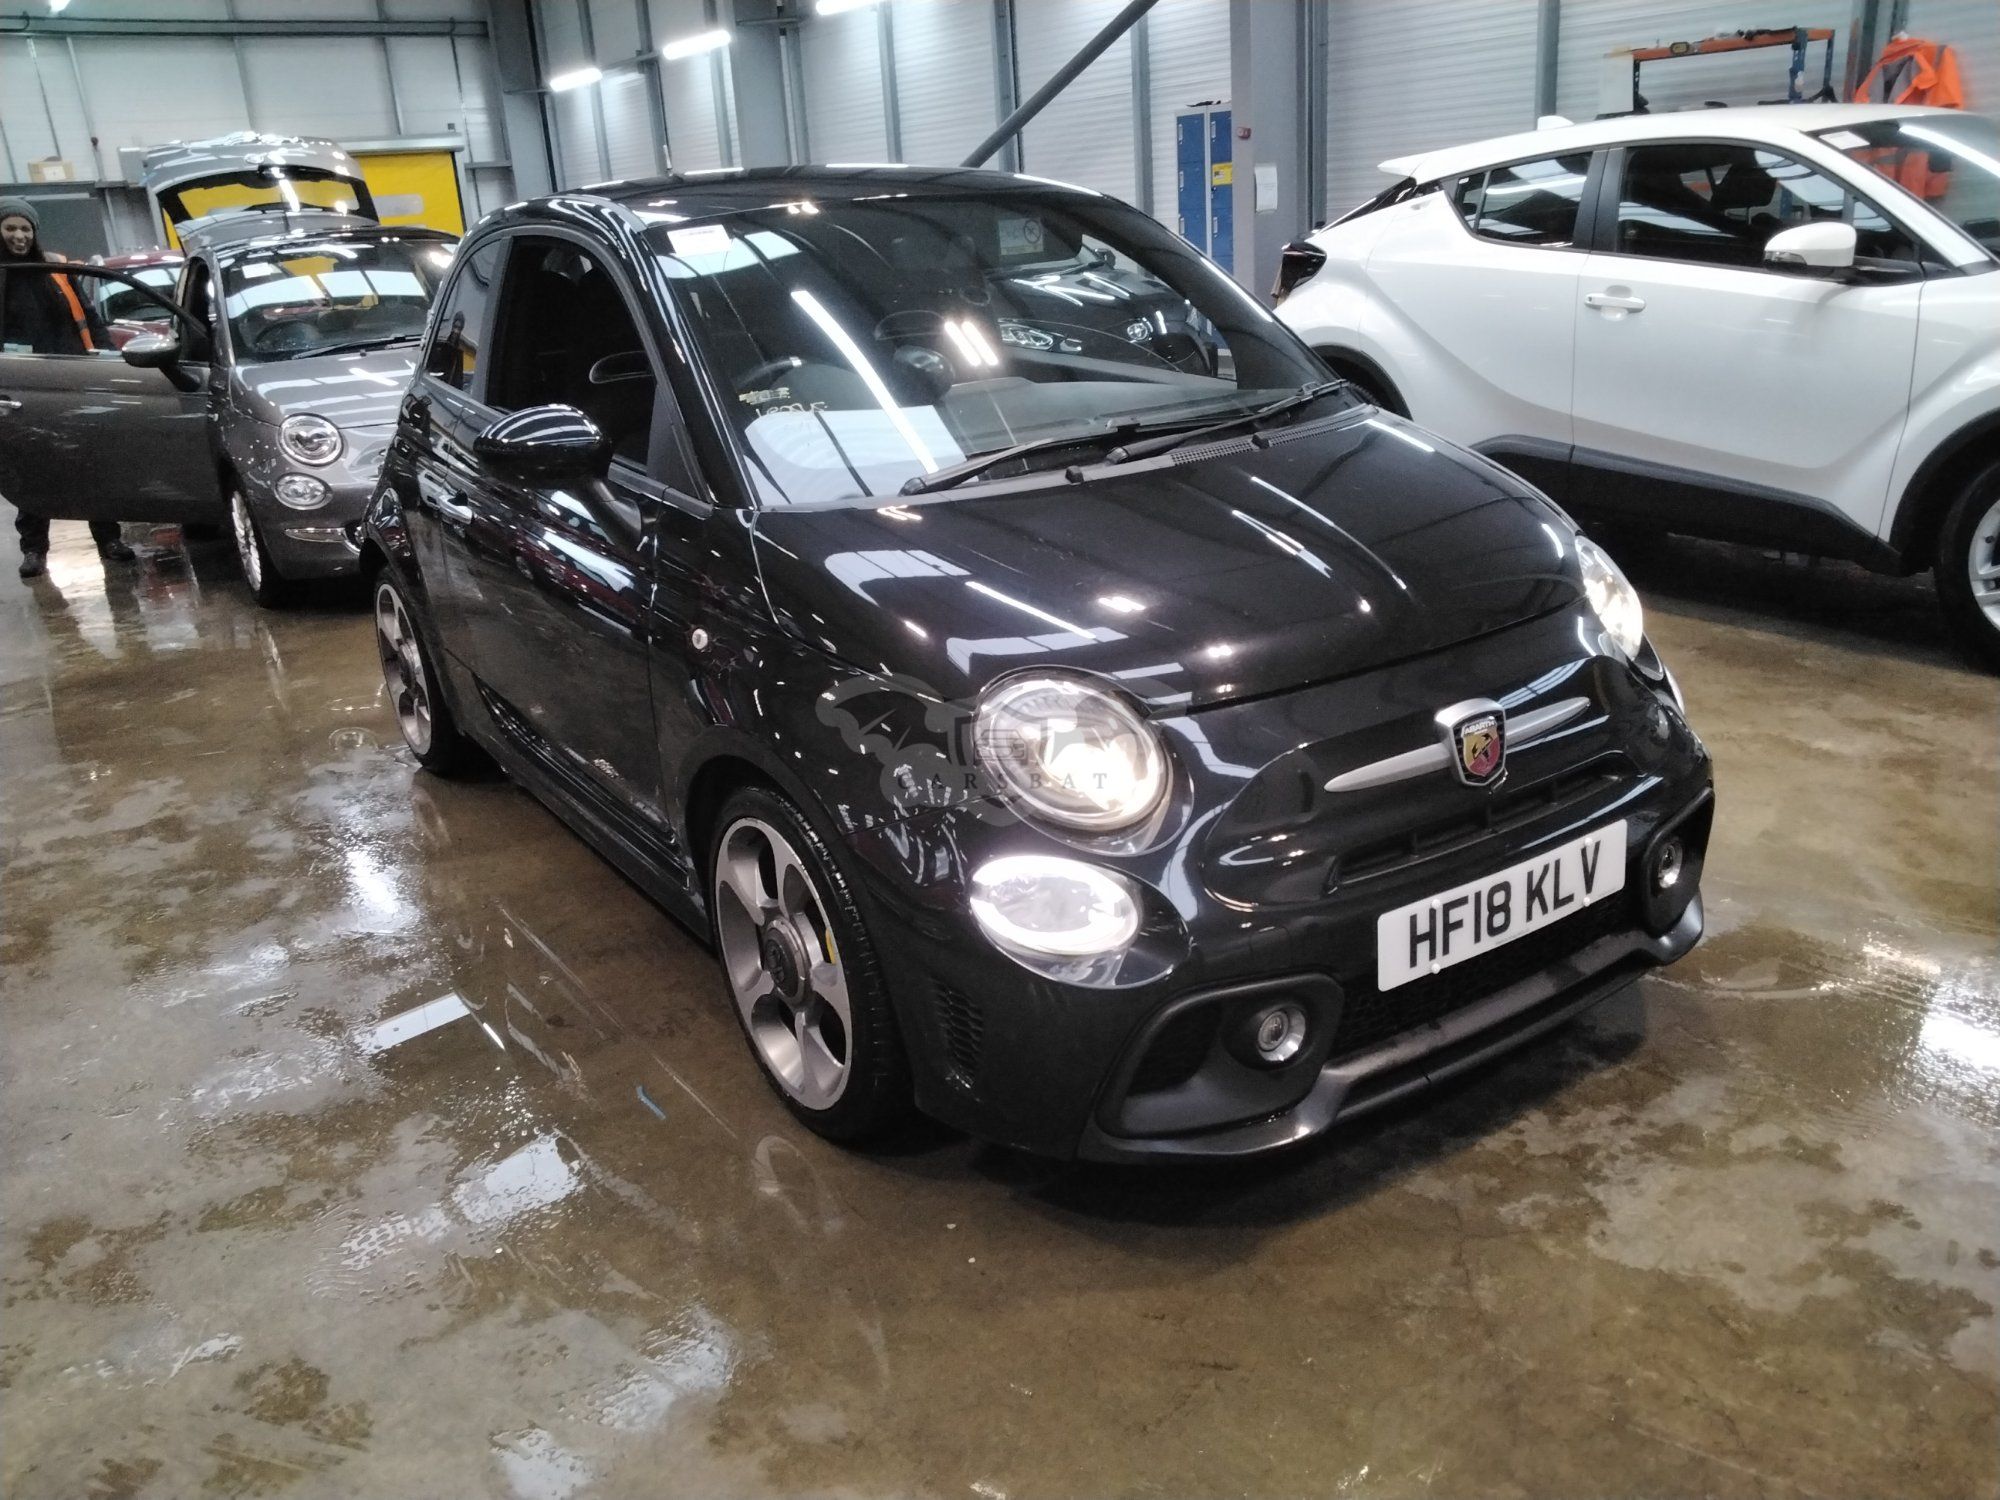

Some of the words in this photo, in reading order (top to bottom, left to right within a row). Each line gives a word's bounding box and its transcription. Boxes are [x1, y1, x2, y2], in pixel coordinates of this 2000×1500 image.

[1464, 720, 1496, 735] ABARTH
[1409, 880, 1512, 969] HF18
[1526, 839, 1602, 923] KLV
